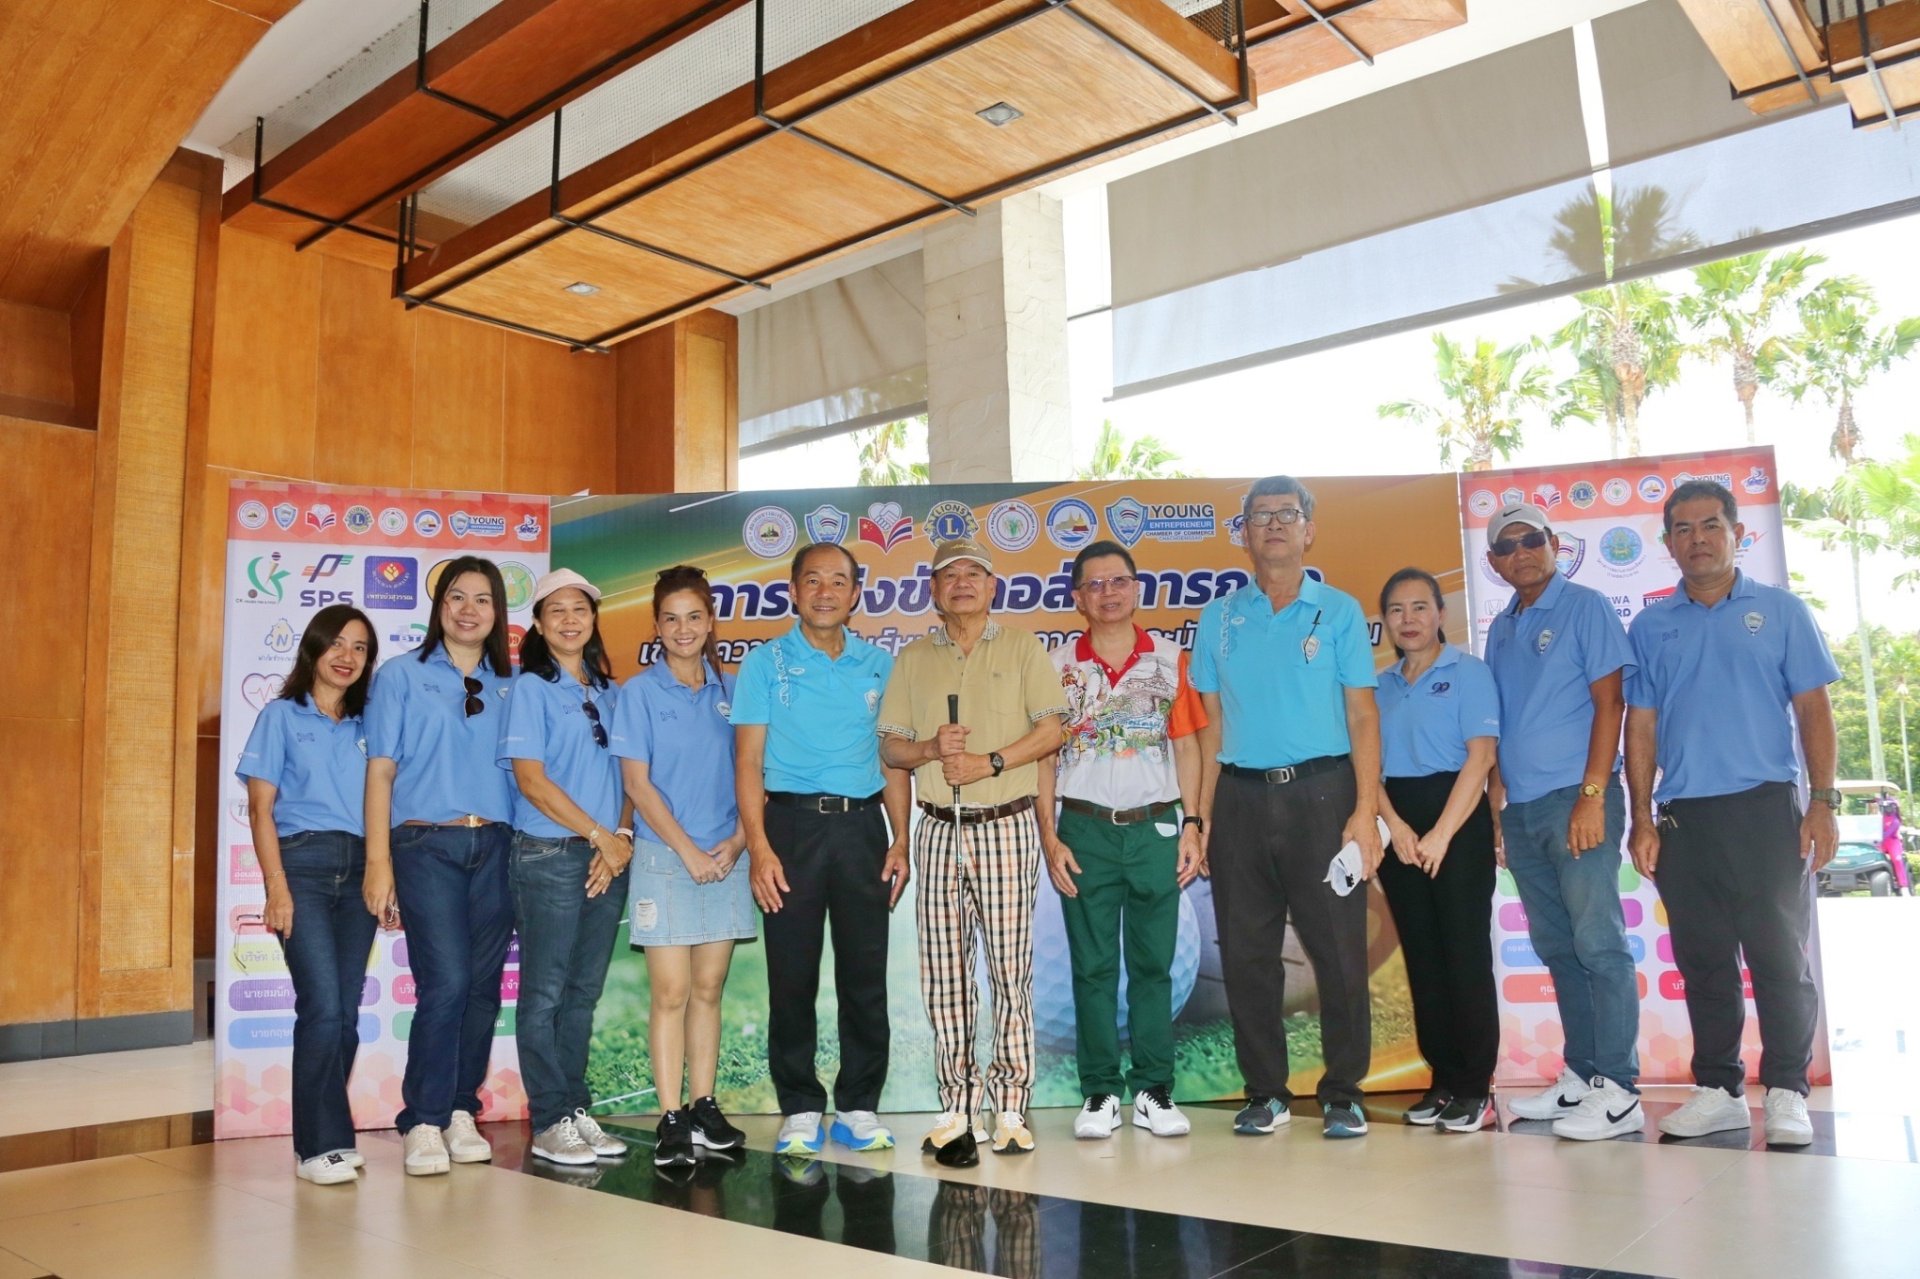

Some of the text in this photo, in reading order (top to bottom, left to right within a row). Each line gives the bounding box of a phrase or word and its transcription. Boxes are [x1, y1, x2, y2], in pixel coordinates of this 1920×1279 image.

[934, 504, 966, 516] LIONS
[1151, 504, 1214, 518] YOUNG
[472, 517, 505, 525] YOUNG
[944, 517, 959, 536] L
[1149, 520, 1212, 530] ENTREPRENEUR
[300, 589, 354, 608] SPS
